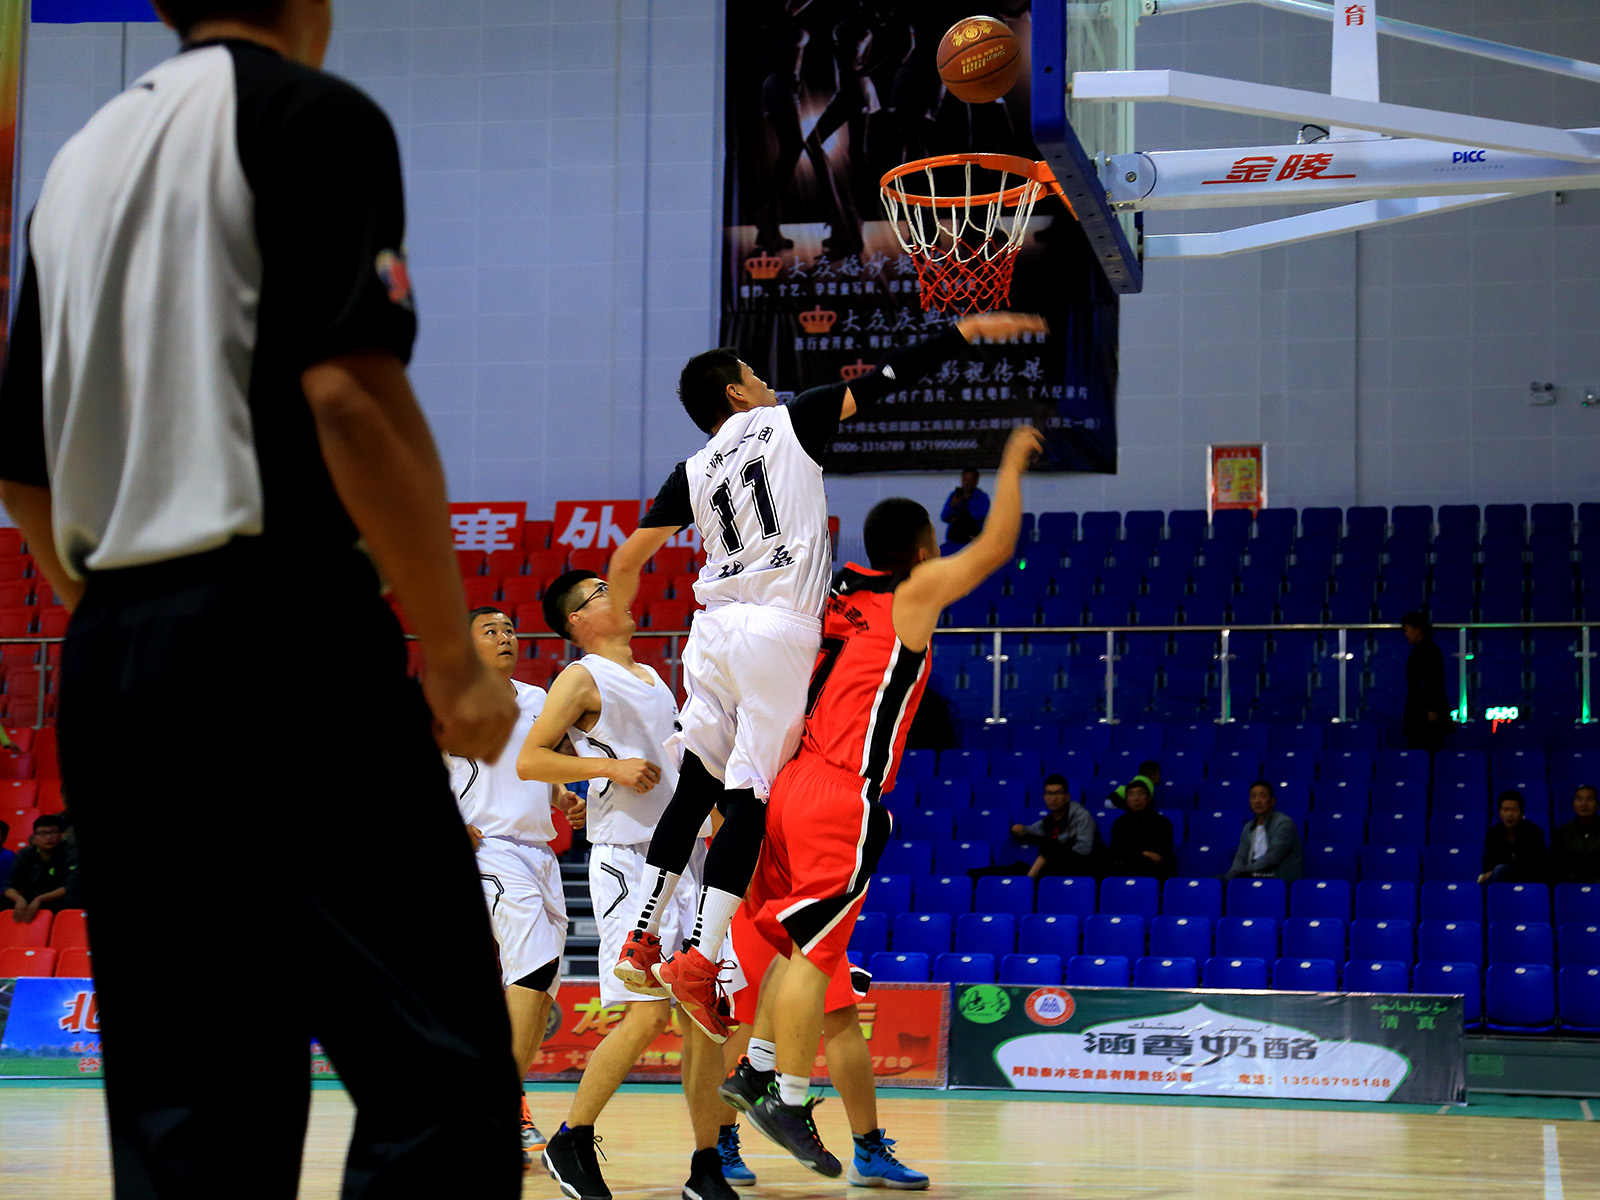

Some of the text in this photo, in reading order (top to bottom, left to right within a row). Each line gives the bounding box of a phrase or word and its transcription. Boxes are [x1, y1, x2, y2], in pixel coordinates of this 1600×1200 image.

[1344, 4, 1366, 26] 育
[1201, 153, 1356, 185] 金陵
[1452, 150, 1486, 164] PICC
[918, 357, 1044, 384] 影视传媒
[709, 455, 781, 556] 11
[1282, 1075, 1391, 1088] 13565795188
